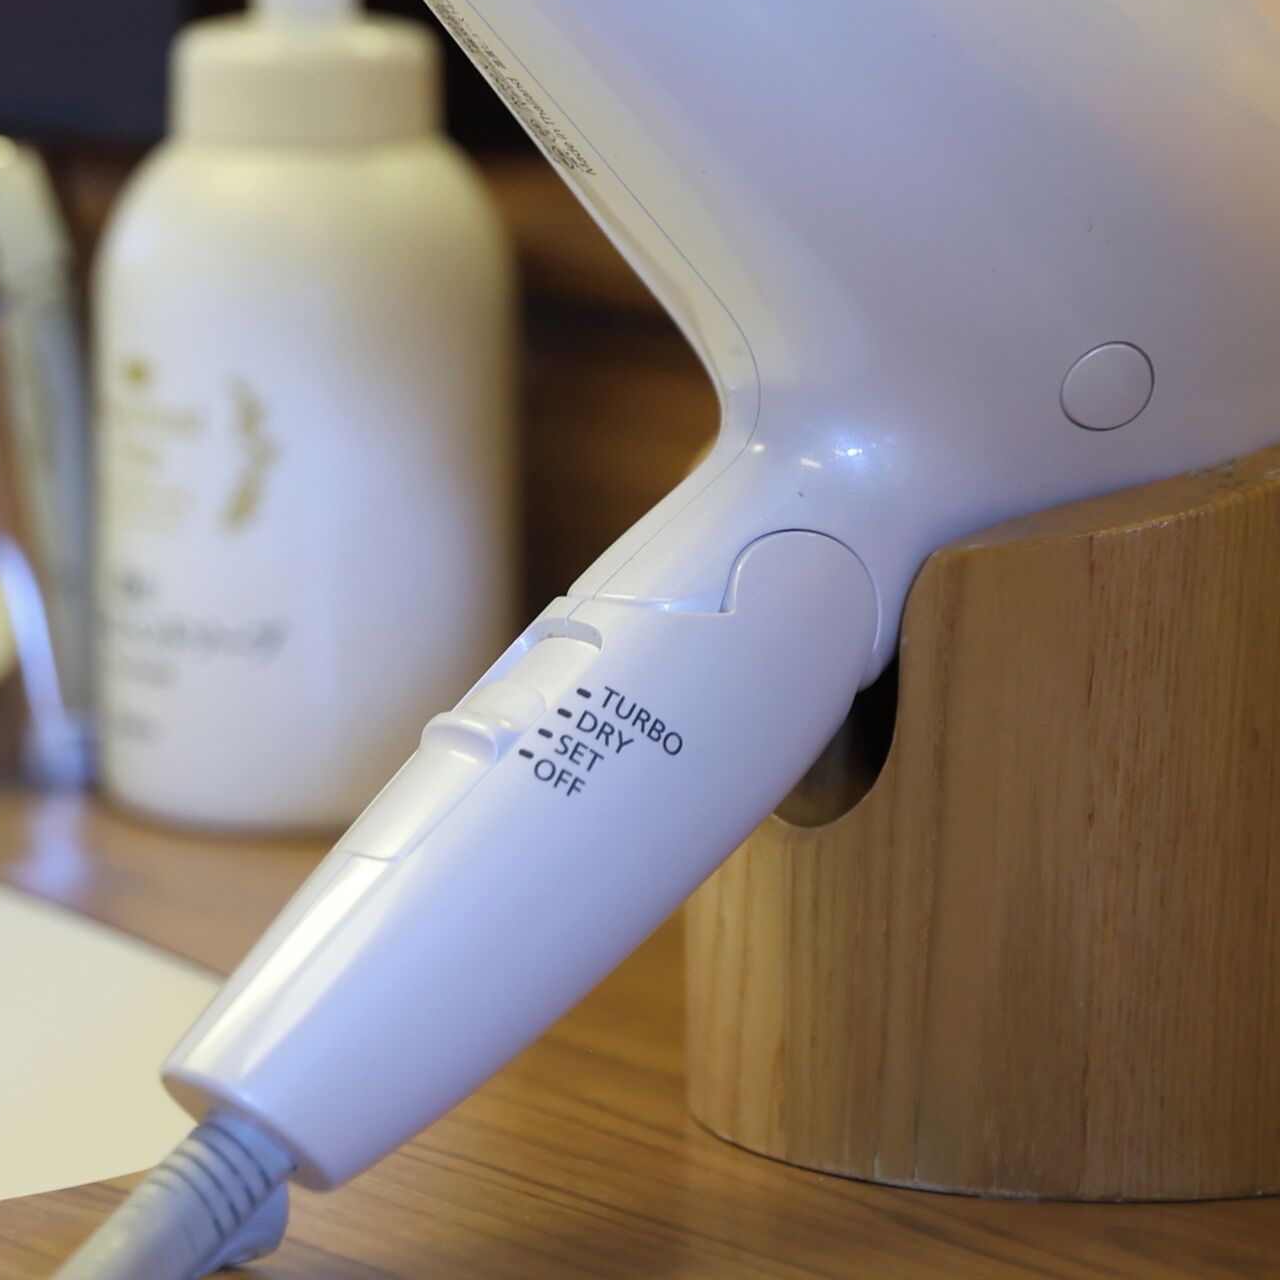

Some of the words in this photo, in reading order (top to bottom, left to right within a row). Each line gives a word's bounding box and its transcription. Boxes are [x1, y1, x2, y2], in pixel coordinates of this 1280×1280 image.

[575, 709, 635, 755] DRY
[600, 685, 684, 756] TURBO
[554, 733, 605, 772] SET
[533, 758, 586, 797] OFF
